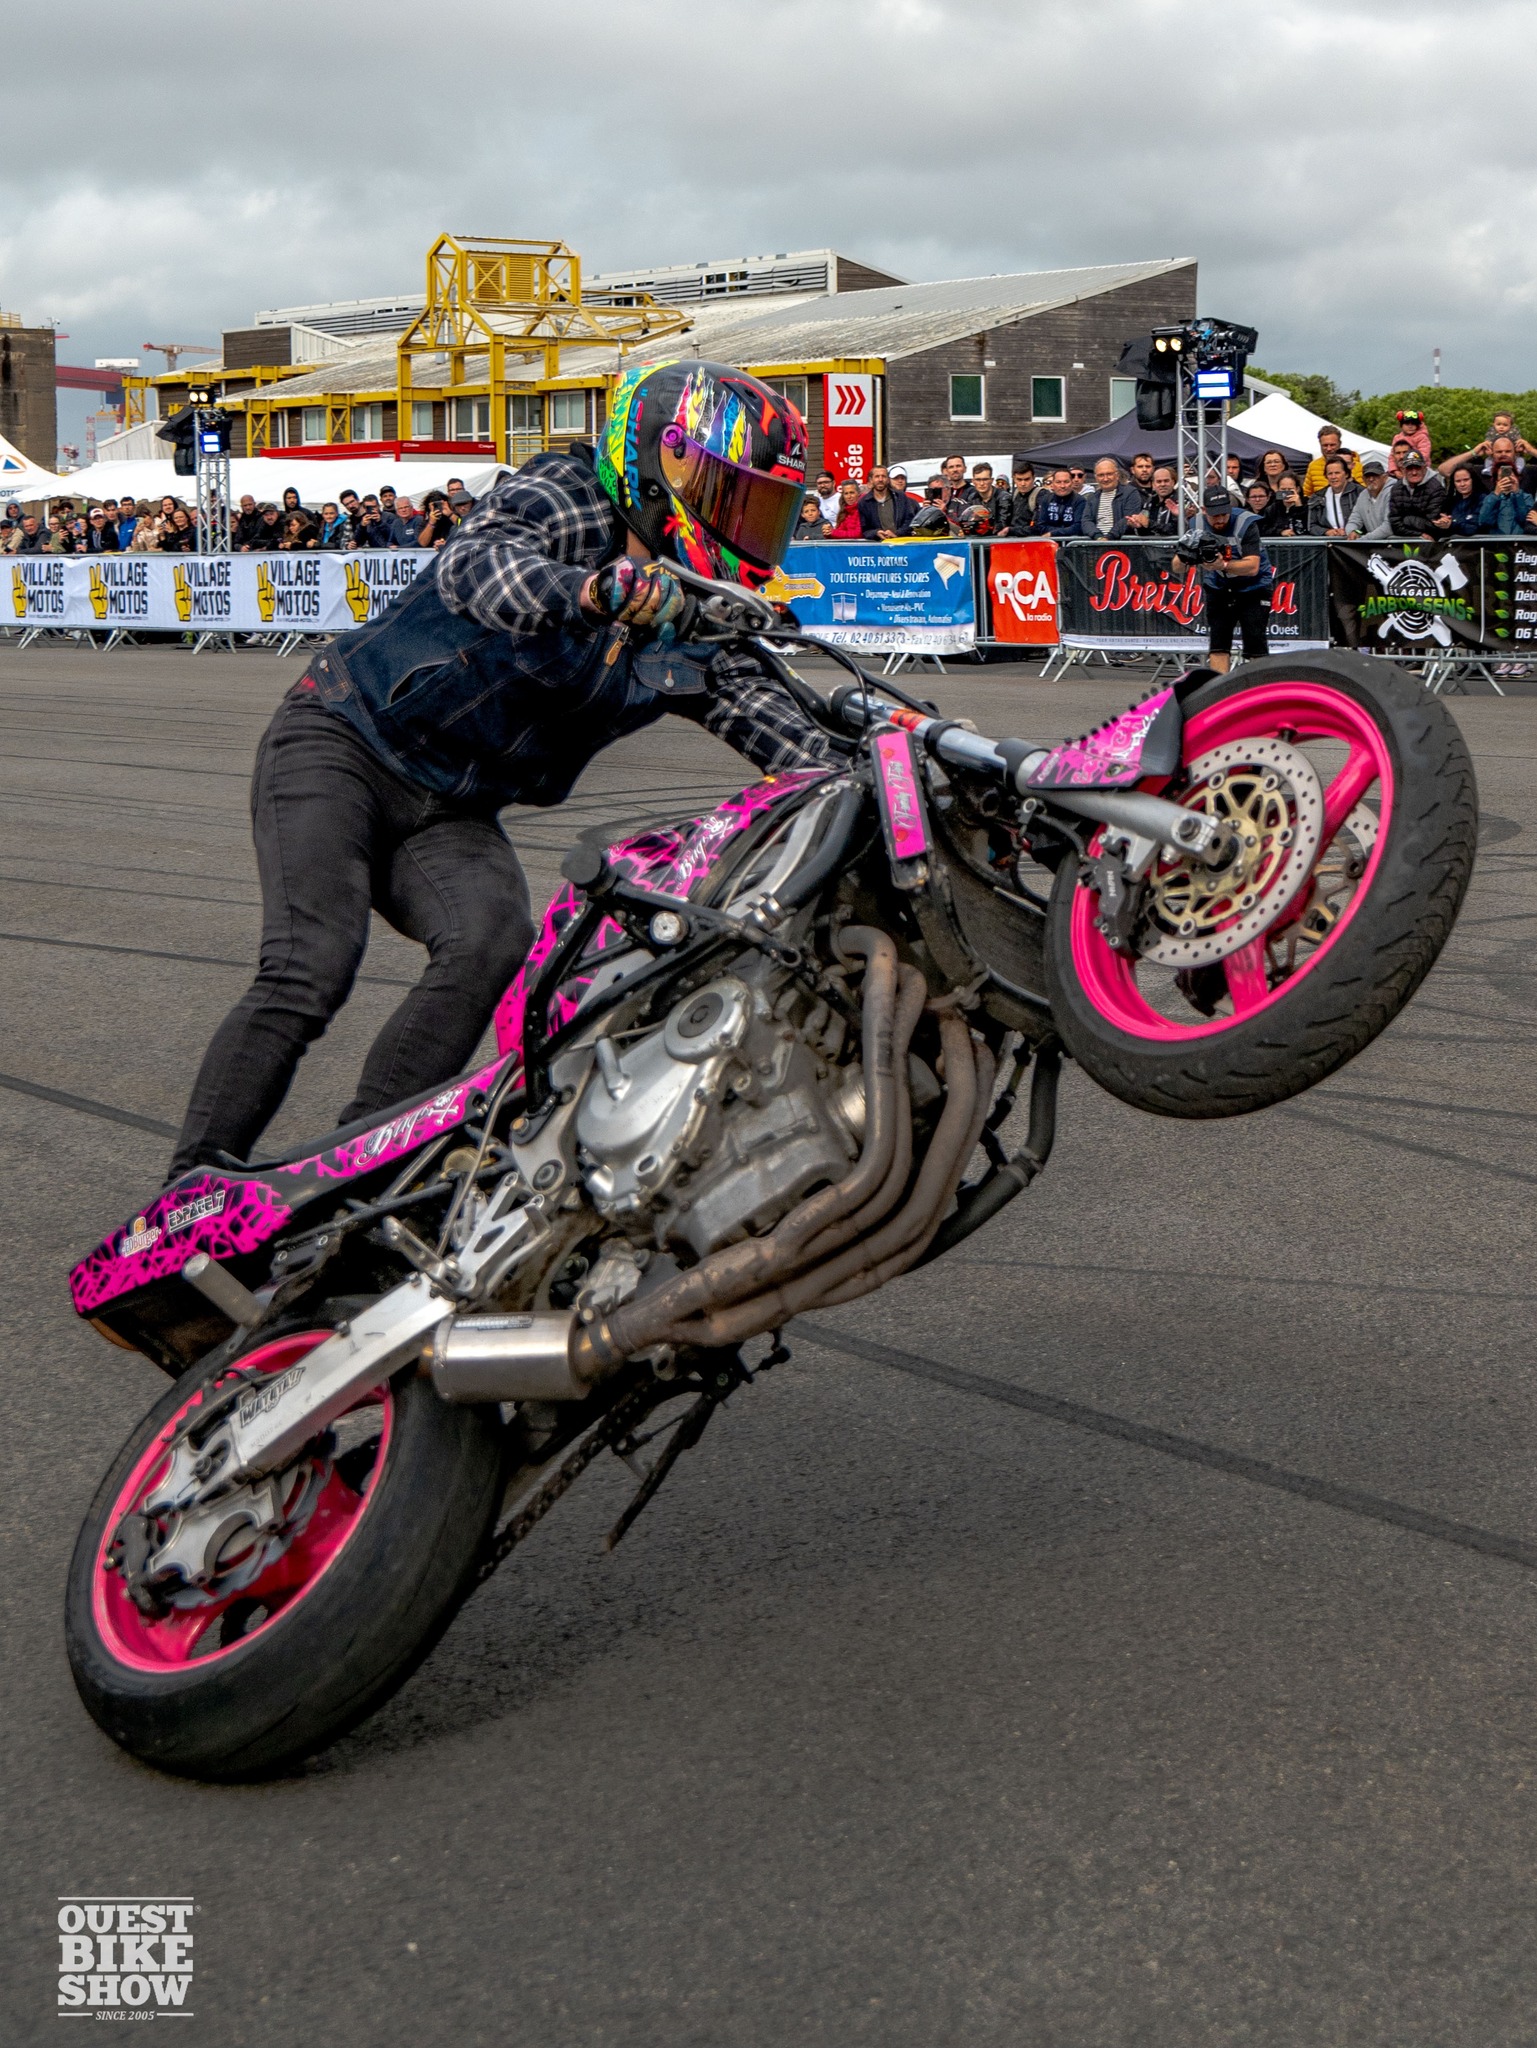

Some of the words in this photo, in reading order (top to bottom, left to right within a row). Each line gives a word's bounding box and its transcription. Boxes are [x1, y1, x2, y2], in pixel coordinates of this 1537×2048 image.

[624, 399, 644, 511] SHARK
[22, 562, 64, 587] VILLAGE
[104, 562, 148, 587] VILLAGE
[186, 561, 231, 587] VILLAGE
[270, 560, 320, 586] VILLAGE
[364, 558, 417, 586] VILLAGE
[847, 556, 876, 568] VOLETS,
[877, 556, 909, 567] PORTAILS
[829, 573, 857, 584] TOUTES
[858, 573, 902, 584] FERMETURES
[903, 571, 930, 583] STORES
[1090, 550, 1205, 625] Breizh
[1514, 571, 1537, 582] Aba
[27, 589, 64, 613] MOTOS
[109, 590, 148, 614] MOTOS
[193, 589, 231, 616] MOTOS
[276, 589, 320, 617] MOTOS
[994, 570, 1056, 621] RCA
[1026, 613, 1033, 621] la
[1034, 613, 1053, 621] radio
[1270, 624, 1300, 635] Ouest
[831, 632, 847, 644] Tél.
[1514, 627, 1532, 639] 06
[168, 1194, 213, 1228] ESPACE
